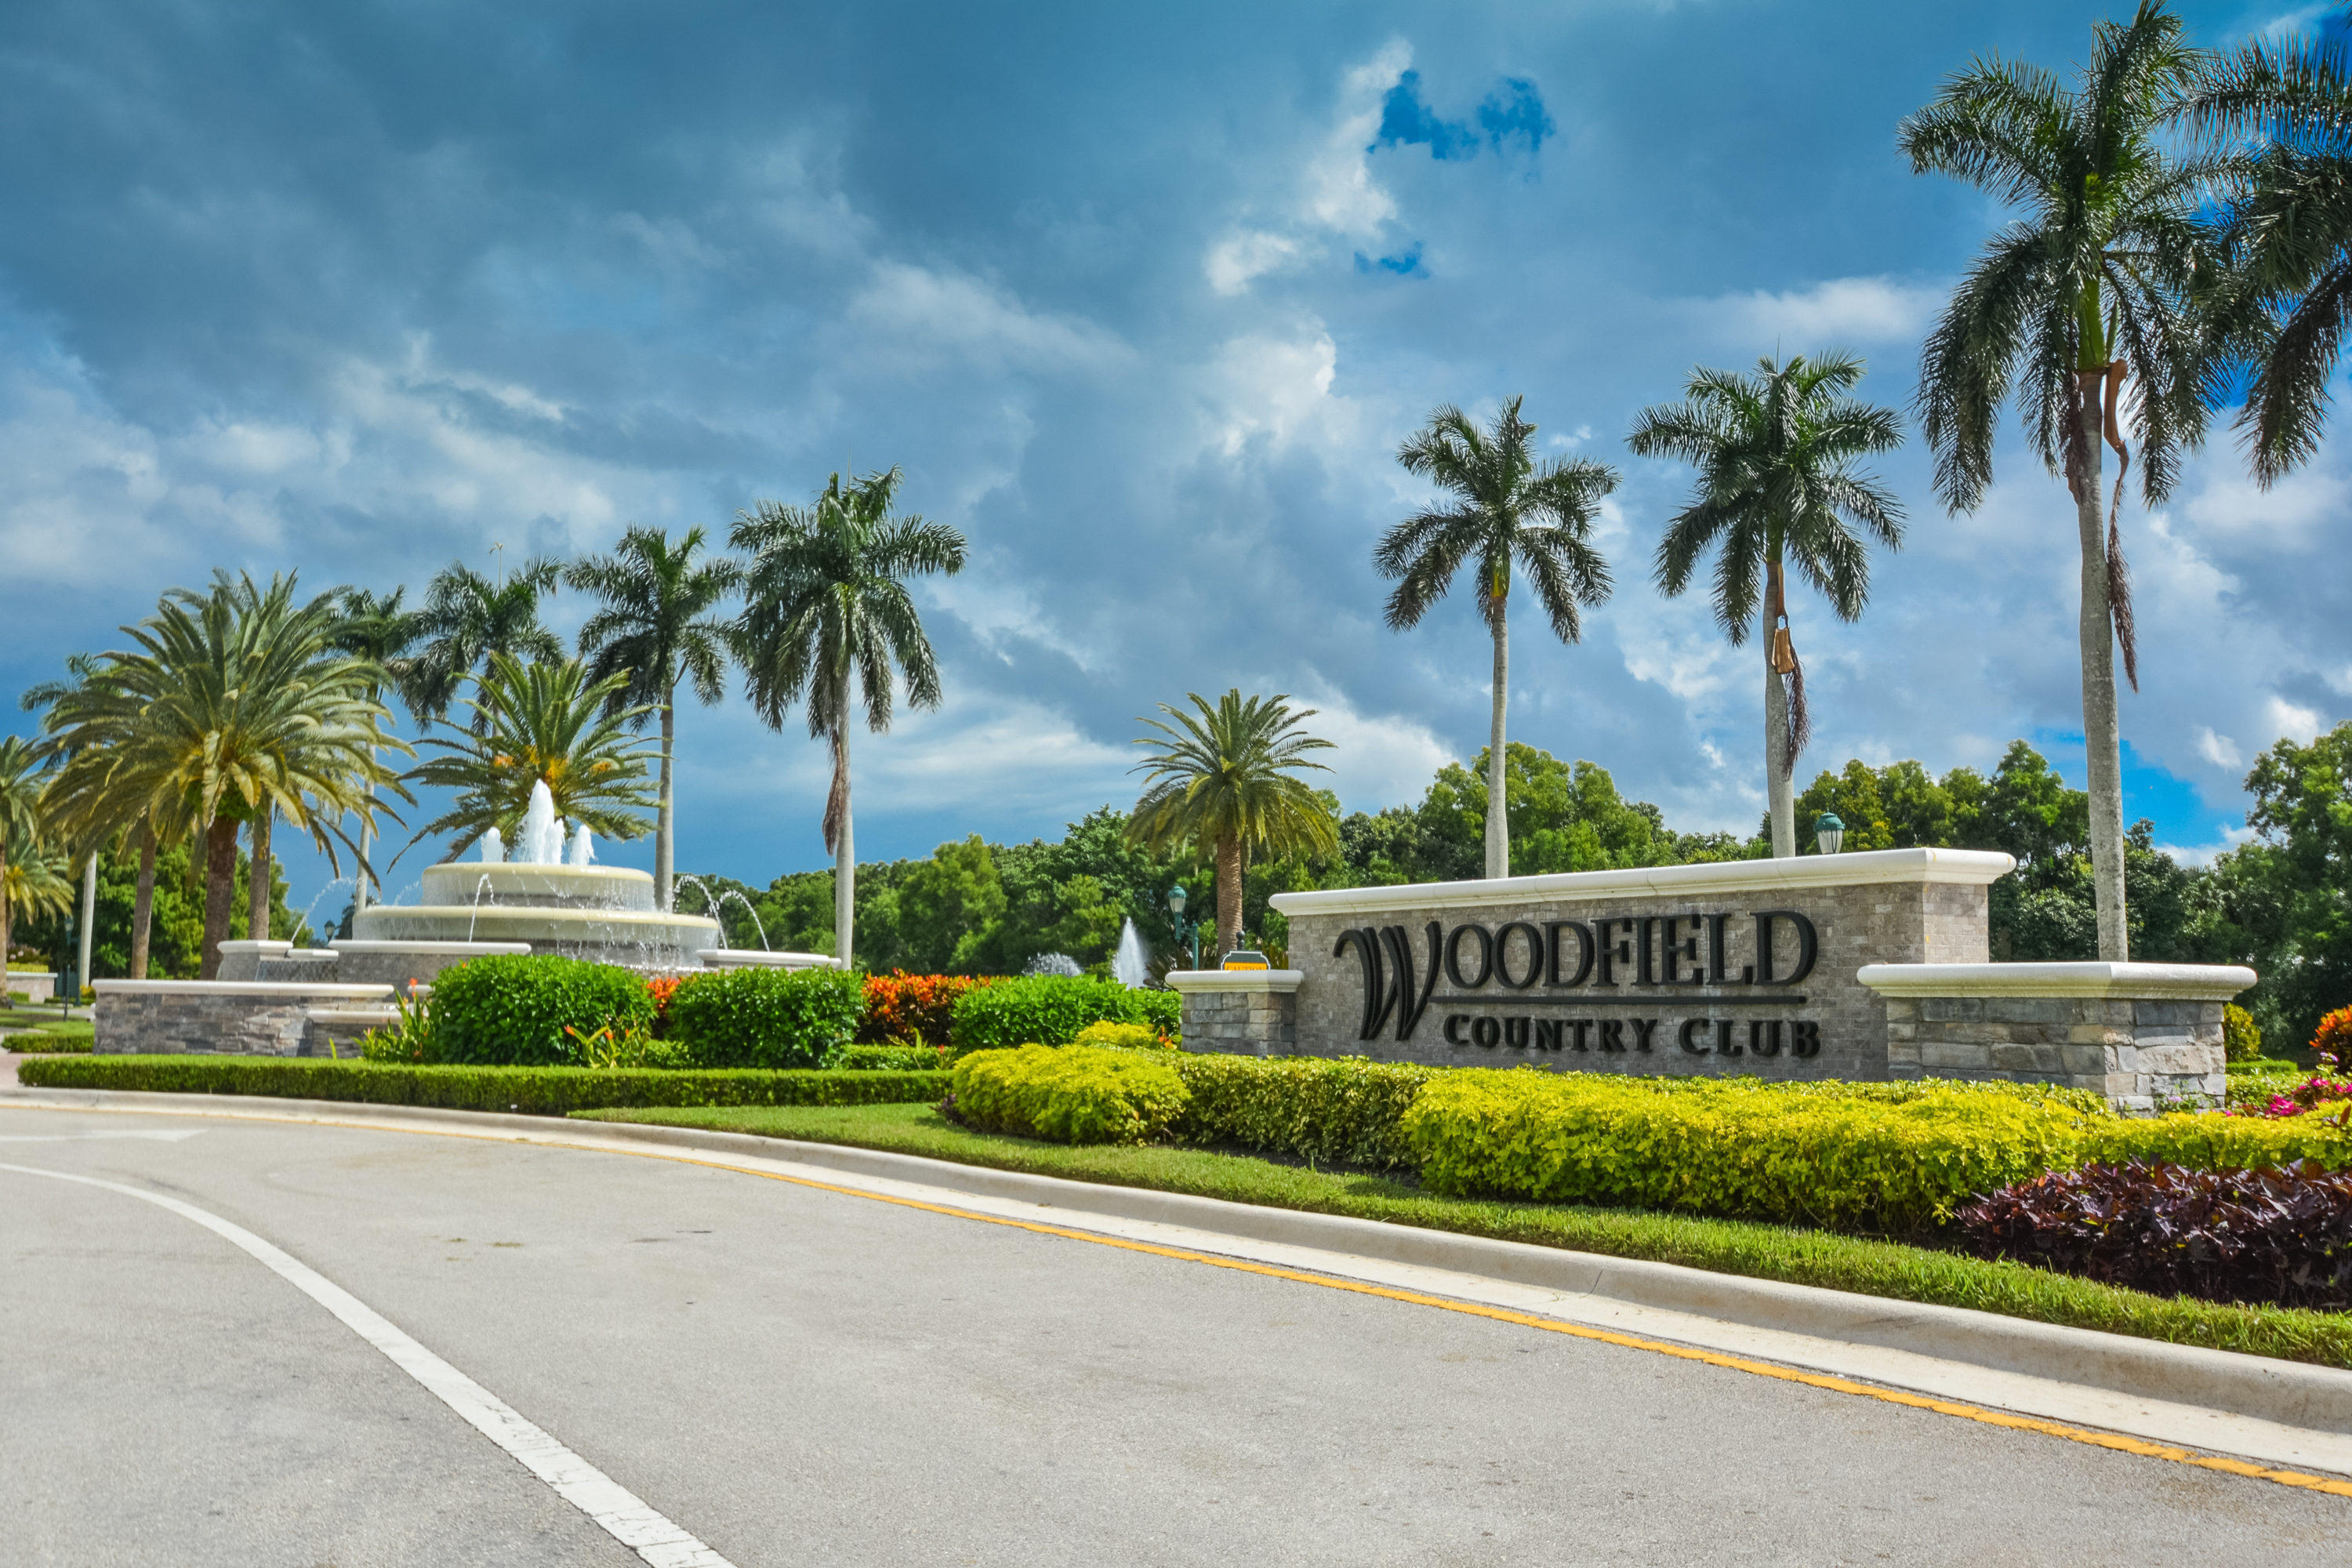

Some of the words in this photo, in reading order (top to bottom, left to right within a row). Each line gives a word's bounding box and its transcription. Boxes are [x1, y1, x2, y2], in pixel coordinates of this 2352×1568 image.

[1334, 911, 1818, 1041] WOODFIELD
[1443, 1014, 1658, 1053] COUNTRY
[1678, 1019, 1821, 1058] CLUB
